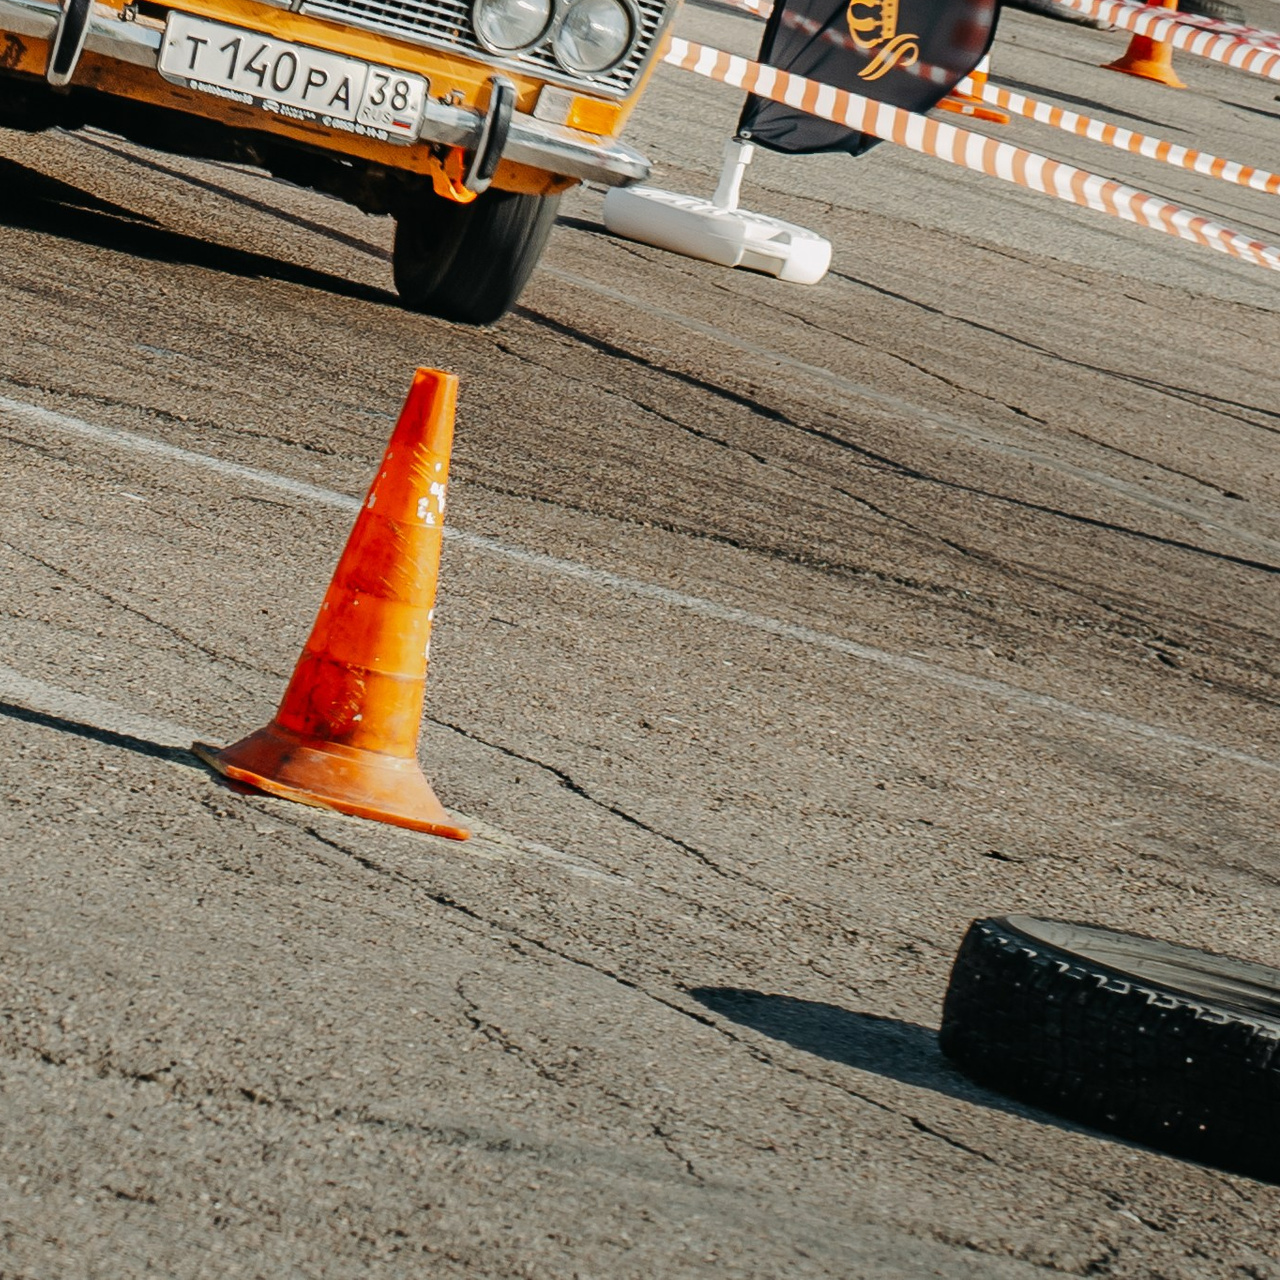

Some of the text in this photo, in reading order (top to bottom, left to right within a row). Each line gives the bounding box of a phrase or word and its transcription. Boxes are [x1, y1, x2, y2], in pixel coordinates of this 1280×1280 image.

[186, 35, 351, 111] Т140РА
[370, 73, 410, 111] 38
[361, 107, 393, 124] RUS
